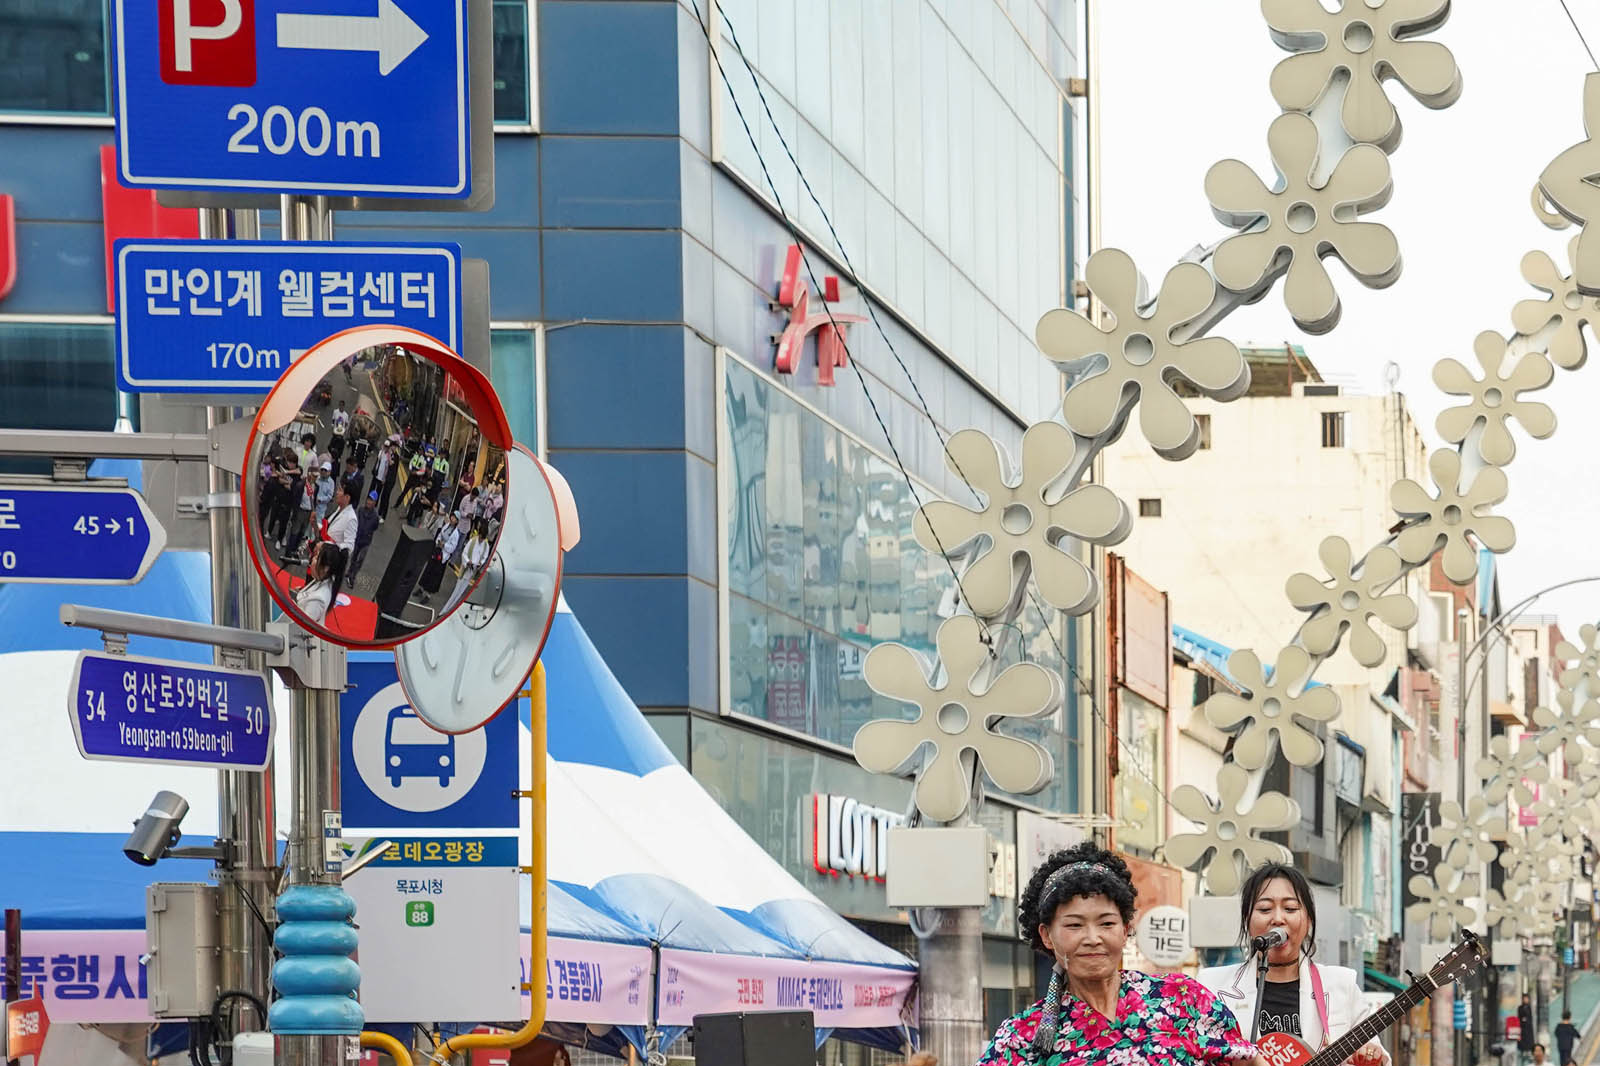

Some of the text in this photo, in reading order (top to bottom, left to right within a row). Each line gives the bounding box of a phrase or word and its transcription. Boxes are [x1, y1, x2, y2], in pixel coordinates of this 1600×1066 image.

[227, 103, 381, 158] 200m
[144, 267, 436, 319] 만인계 웰컴센터
[206, 342, 281, 370] 170m
[0, 550, 17, 570] o
[85, 689, 107, 722] 34
[122, 670, 230, 723] 영산로59번길
[245, 706, 264, 736] 30
[118, 721, 234, 758] Yeongsan-ro 59beon-gil
[382, 841, 485, 863] 로데오광장
[396, 879, 443, 895] 목포시청
[411, 911, 429, 923] 88
[1149, 916, 1185, 932] 보디
[1148, 935, 1183, 953] 가드
[554, 959, 603, 1003] 경품행사
[777, 976, 844, 1010] MIMAF 축제안내소
